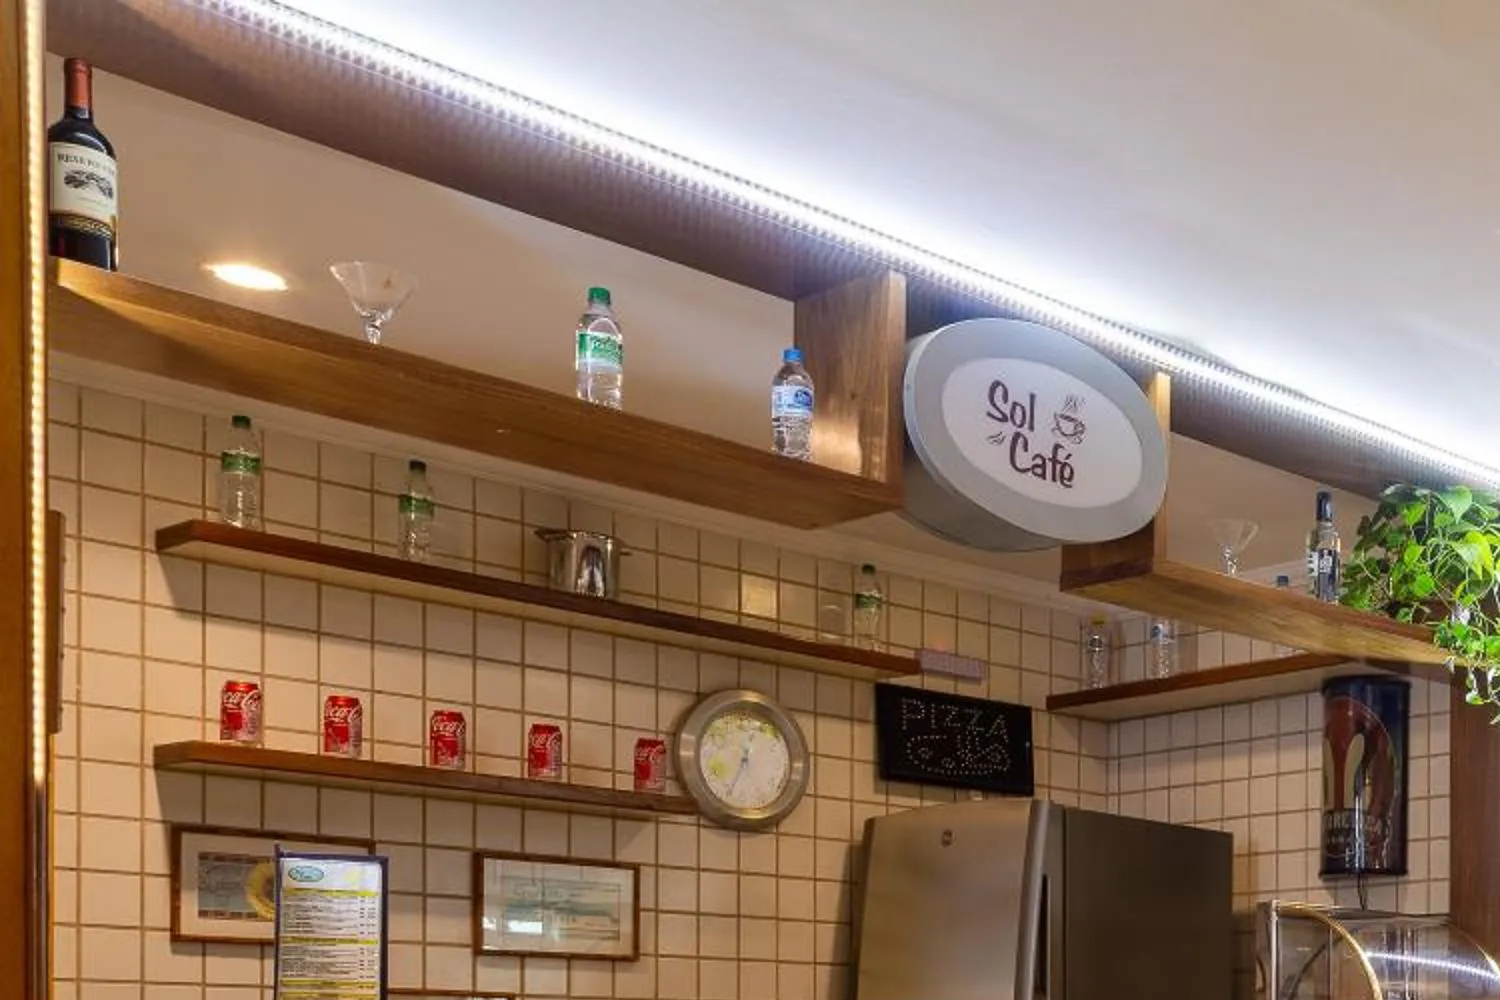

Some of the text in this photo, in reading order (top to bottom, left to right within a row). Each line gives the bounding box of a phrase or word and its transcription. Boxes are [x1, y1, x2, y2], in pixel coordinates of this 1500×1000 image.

[986, 380, 1036, 432] Sol
[1009, 431, 1075, 488] Café
[901, 698, 1010, 744] PIZZA
